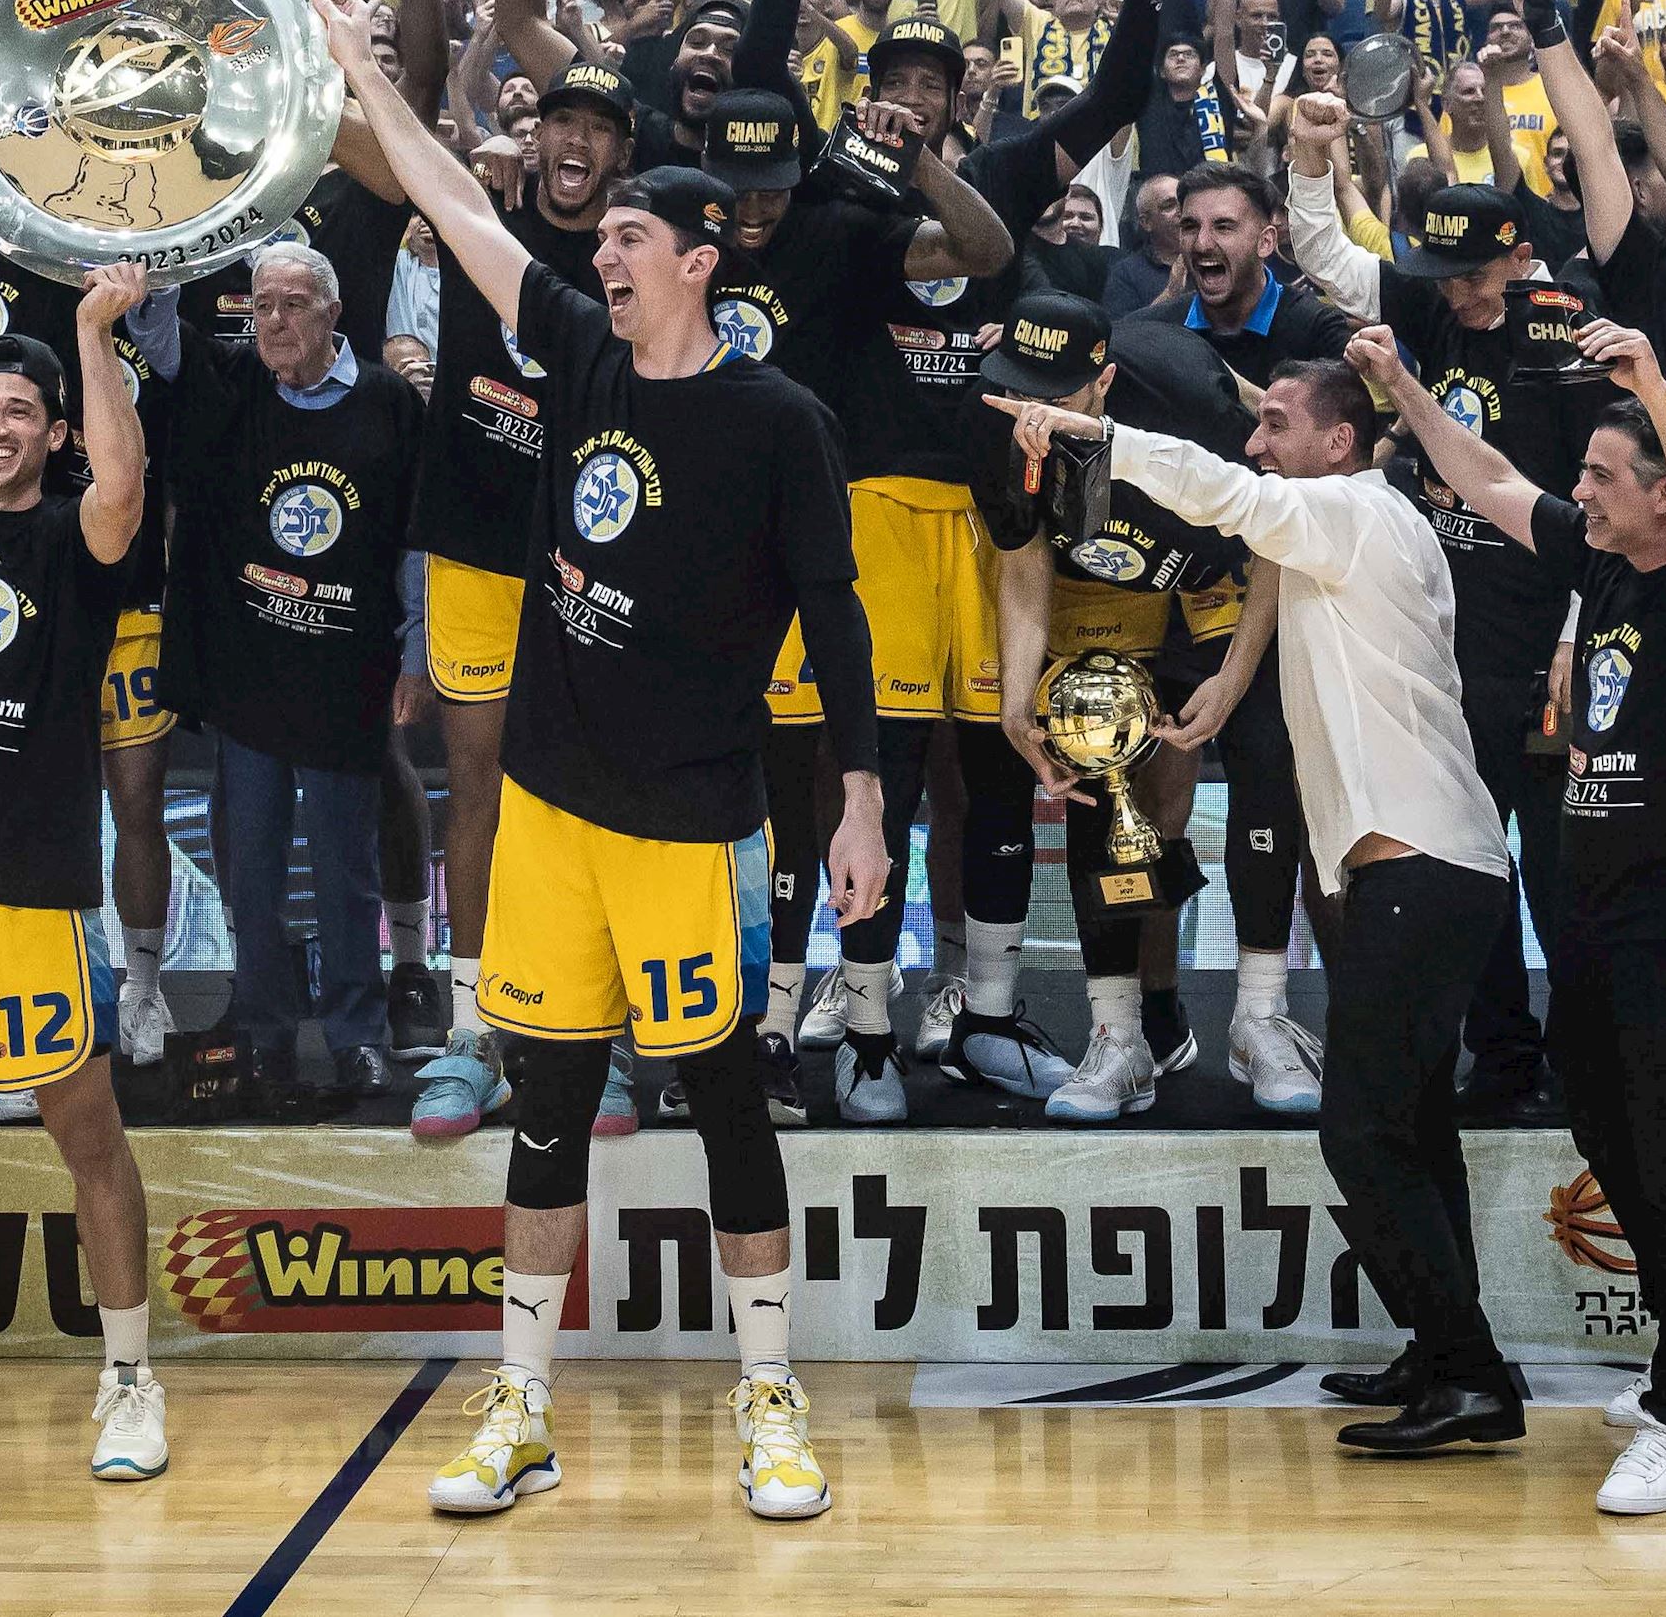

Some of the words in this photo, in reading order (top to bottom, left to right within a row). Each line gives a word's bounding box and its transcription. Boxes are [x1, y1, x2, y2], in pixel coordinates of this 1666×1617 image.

[891, 21, 946, 44] CHAMP
[564, 66, 620, 91] CHAMP
[726, 121, 781, 144] CHAMP
[734, 144, 772, 154] 2023-2024
[844, 136, 901, 174] CHAMP
[1014, 318, 1069, 353] CHAMP
[291, 461, 347, 488] PLAYTIKA
[343, 482, 361, 511] מכבי
[1151, 548, 1185, 590] אלופת
[313, 582, 354, 603] אלופת
[587, 579, 634, 617] אלופת
[266, 593, 327, 625] 2023/24
[1076, 622, 1122, 639] Rapyd
[461, 660, 506, 678] Rapyd
[889, 679, 931, 694] Rapyd
[1591, 752, 1637, 774] אלופת
[499, 981, 544, 1006] Rapyd
[641, 951, 718, 1023] 15
[260, 1230, 505, 1298] Winne
[616, 1175, 928, 1333] לית
